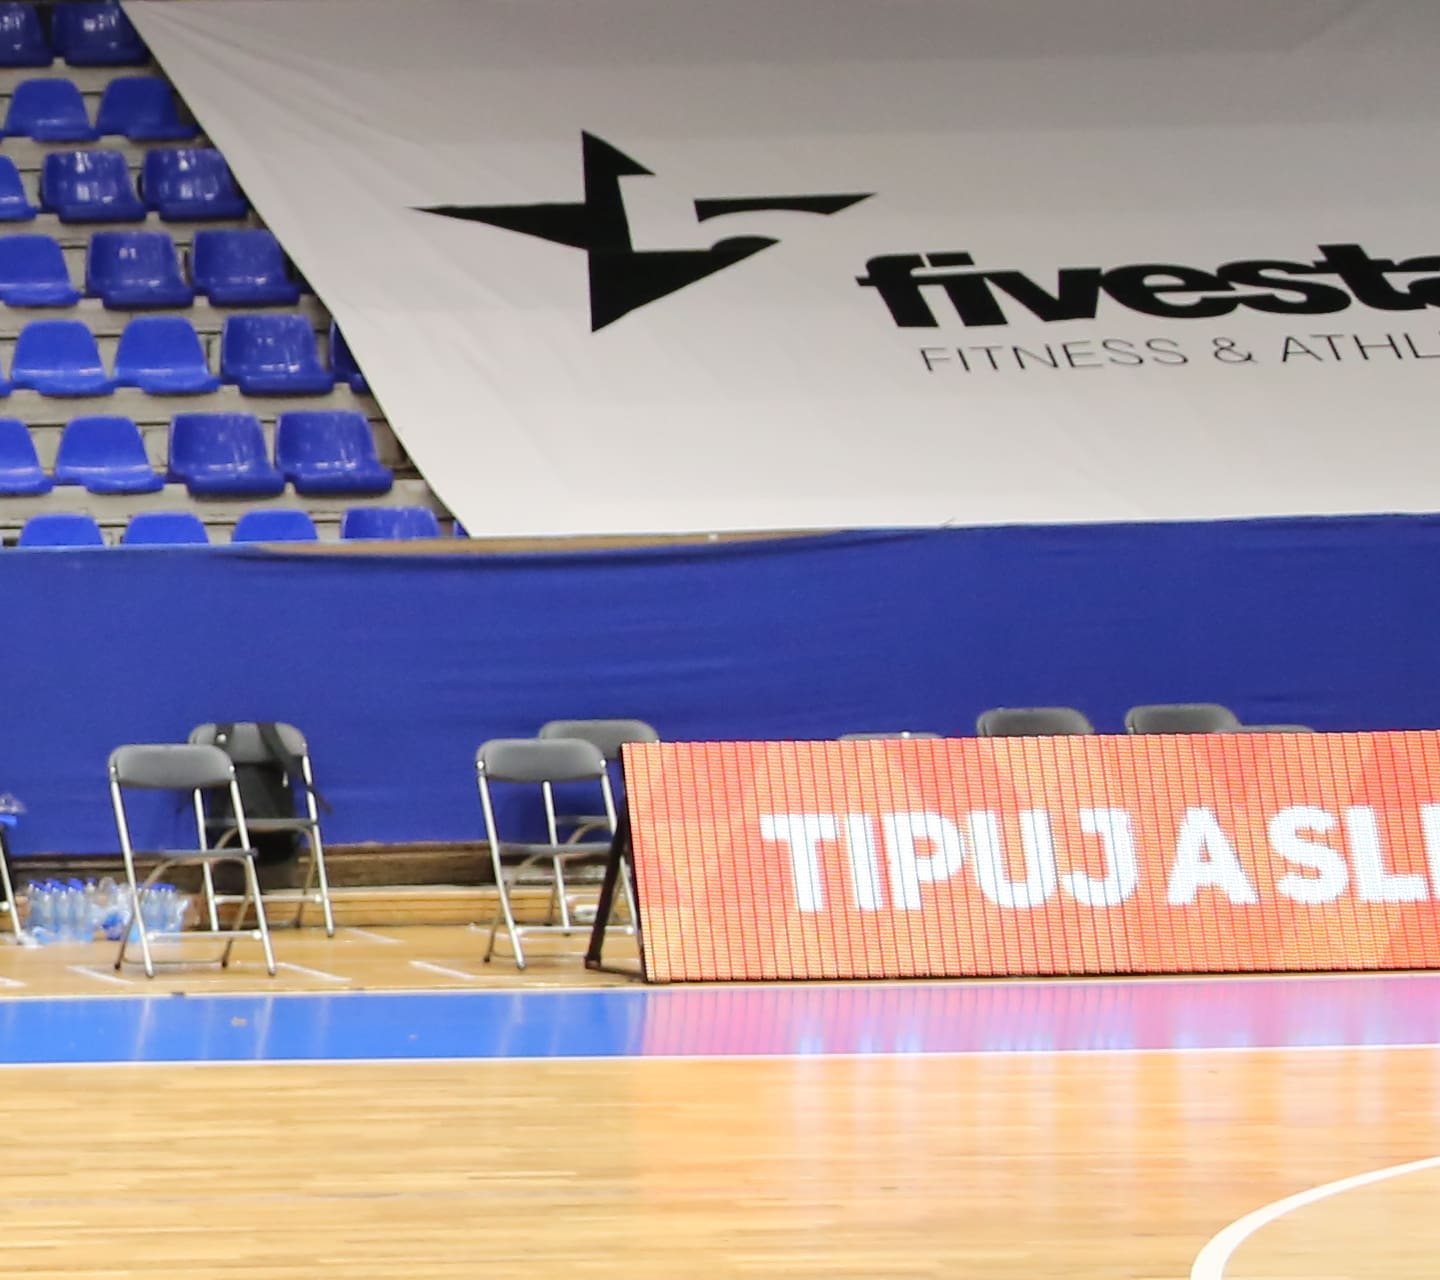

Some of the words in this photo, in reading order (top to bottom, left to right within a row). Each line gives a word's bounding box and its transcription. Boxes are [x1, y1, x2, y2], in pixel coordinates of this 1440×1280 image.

[919, 337, 1188, 373] FITNESS
[1212, 335, 1257, 366] &
[1282, 332, 1440, 365] ATHL
[760, 805, 1141, 913] TIPUJ
[1166, 805, 1261, 905] A
[1267, 803, 1440, 904] SL
